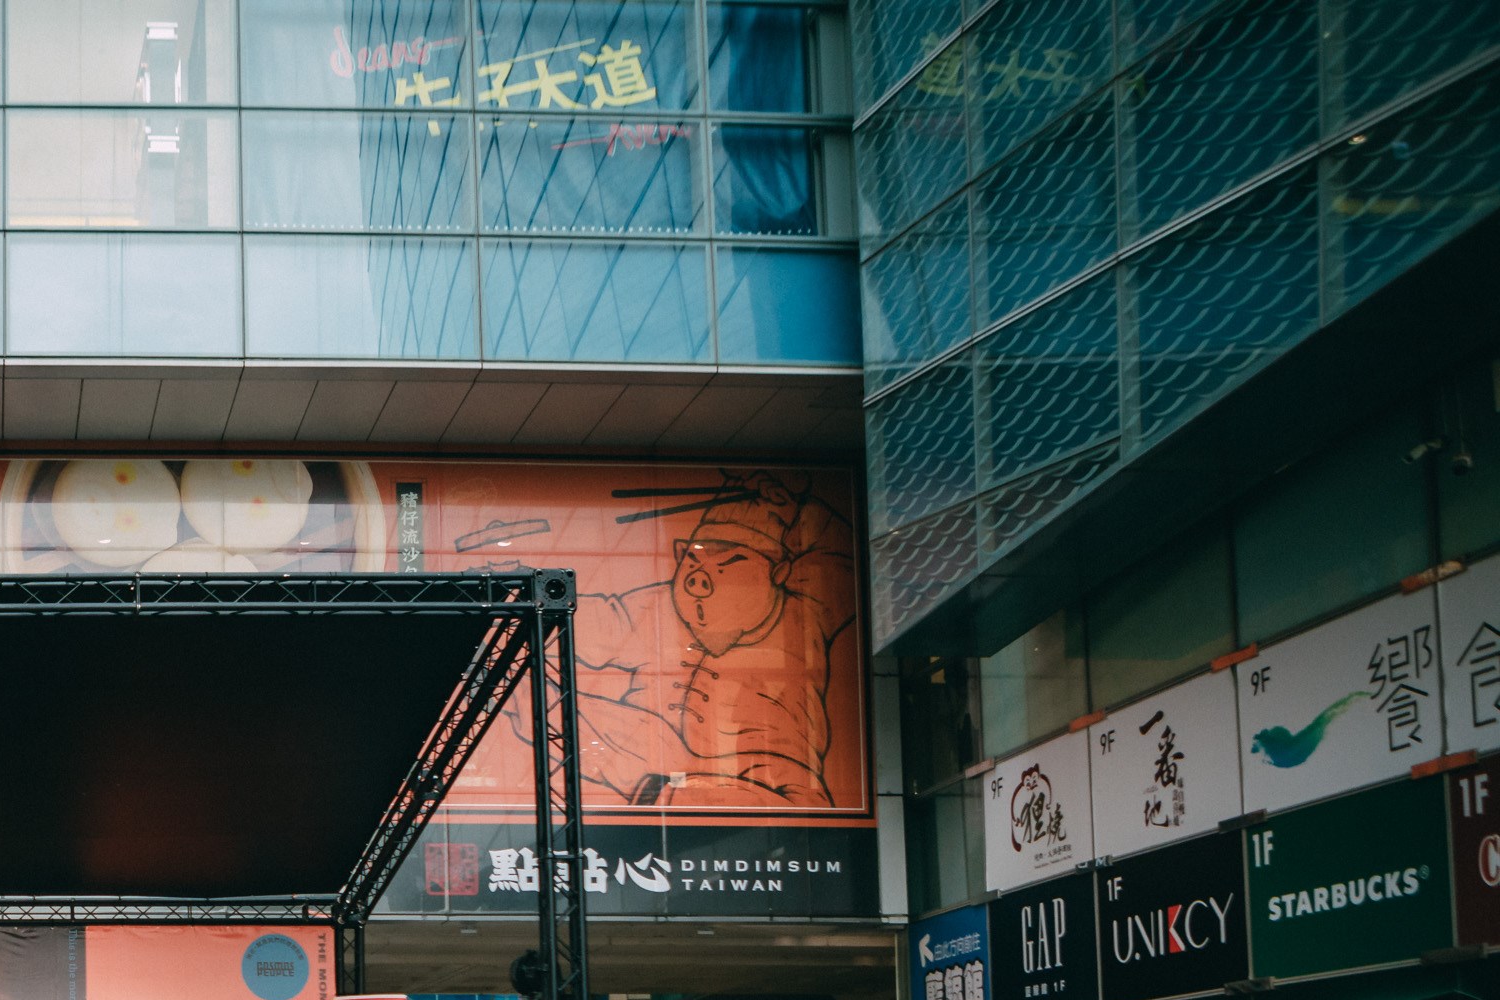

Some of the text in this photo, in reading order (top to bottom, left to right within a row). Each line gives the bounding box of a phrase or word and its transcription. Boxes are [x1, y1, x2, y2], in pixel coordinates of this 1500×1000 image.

[1251, 666, 1271, 696] 9F
[1100, 729, 1116, 756] 9F
[991, 777, 1003, 799] 9F
[1459, 773, 1489, 818] 1F
[1252, 830, 1275, 868] 1F
[681, 859, 842, 874] DIMDIMSUM
[682, 879, 784, 893] TAIWAN
[1107, 876, 1123, 901] 1F
[318, 932, 327, 963] THE
[1021, 897, 1067, 974] GAP
[1053, 979, 1066, 992] 1F
